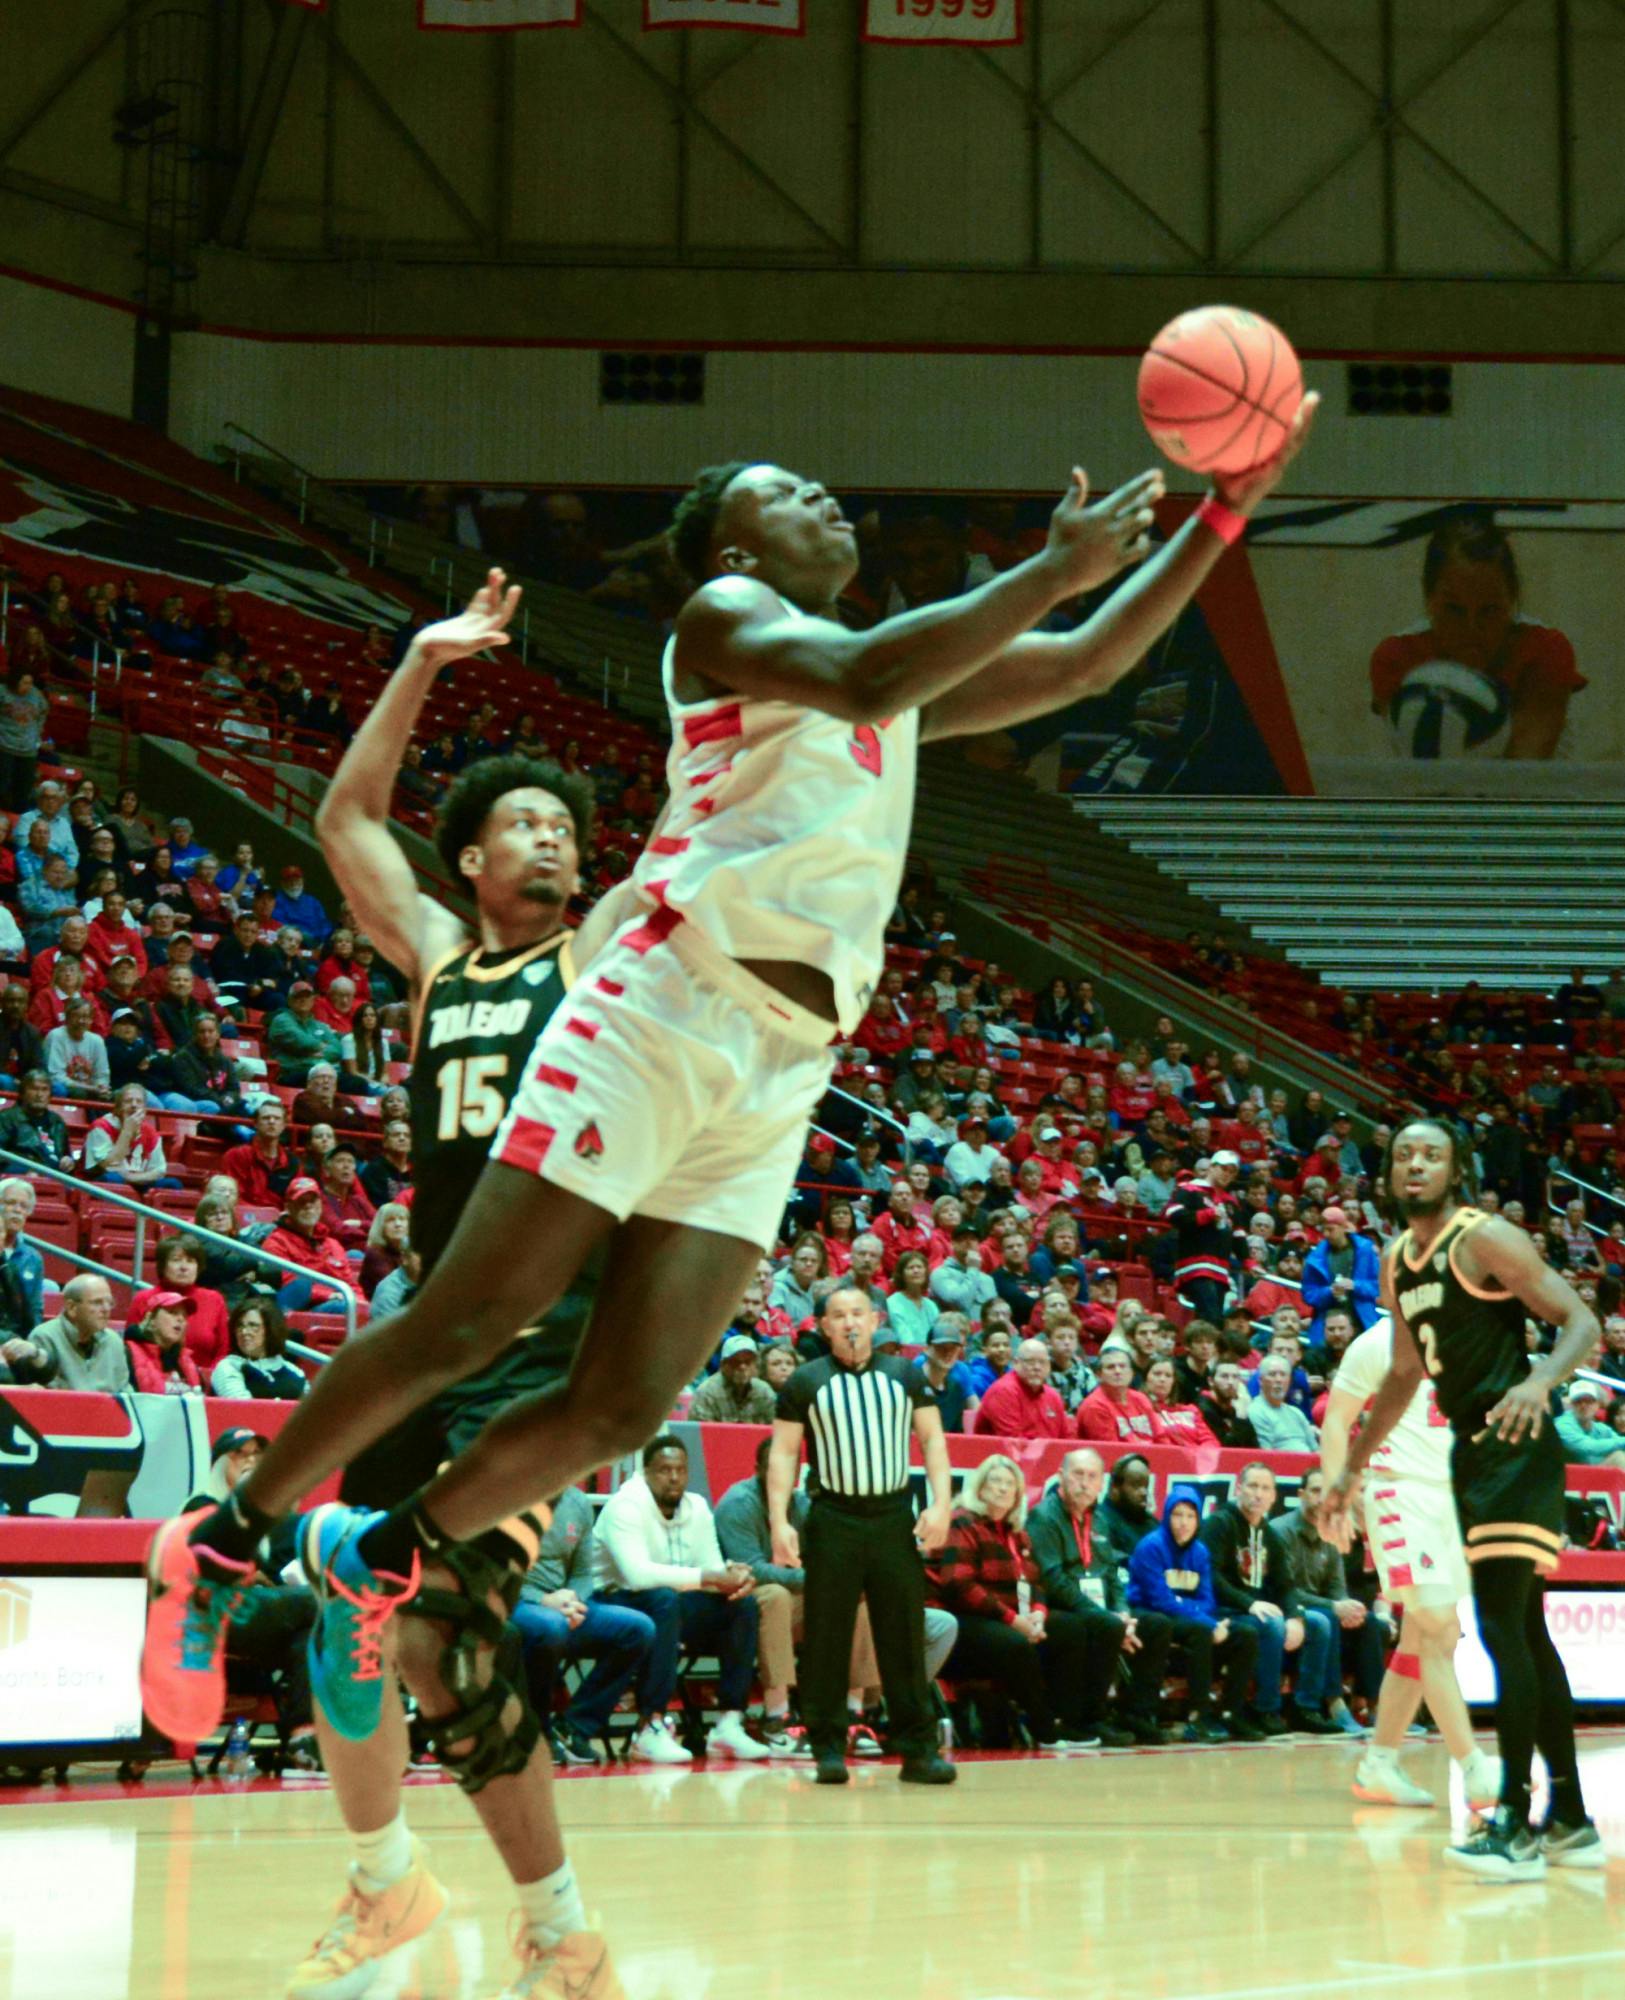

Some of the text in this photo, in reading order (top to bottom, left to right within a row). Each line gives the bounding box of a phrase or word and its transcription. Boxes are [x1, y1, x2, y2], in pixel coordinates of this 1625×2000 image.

[429, 999, 531, 1049] TOLEDO
[437, 1054, 508, 1141] 15
[1544, 1602, 1625, 1640] oop
